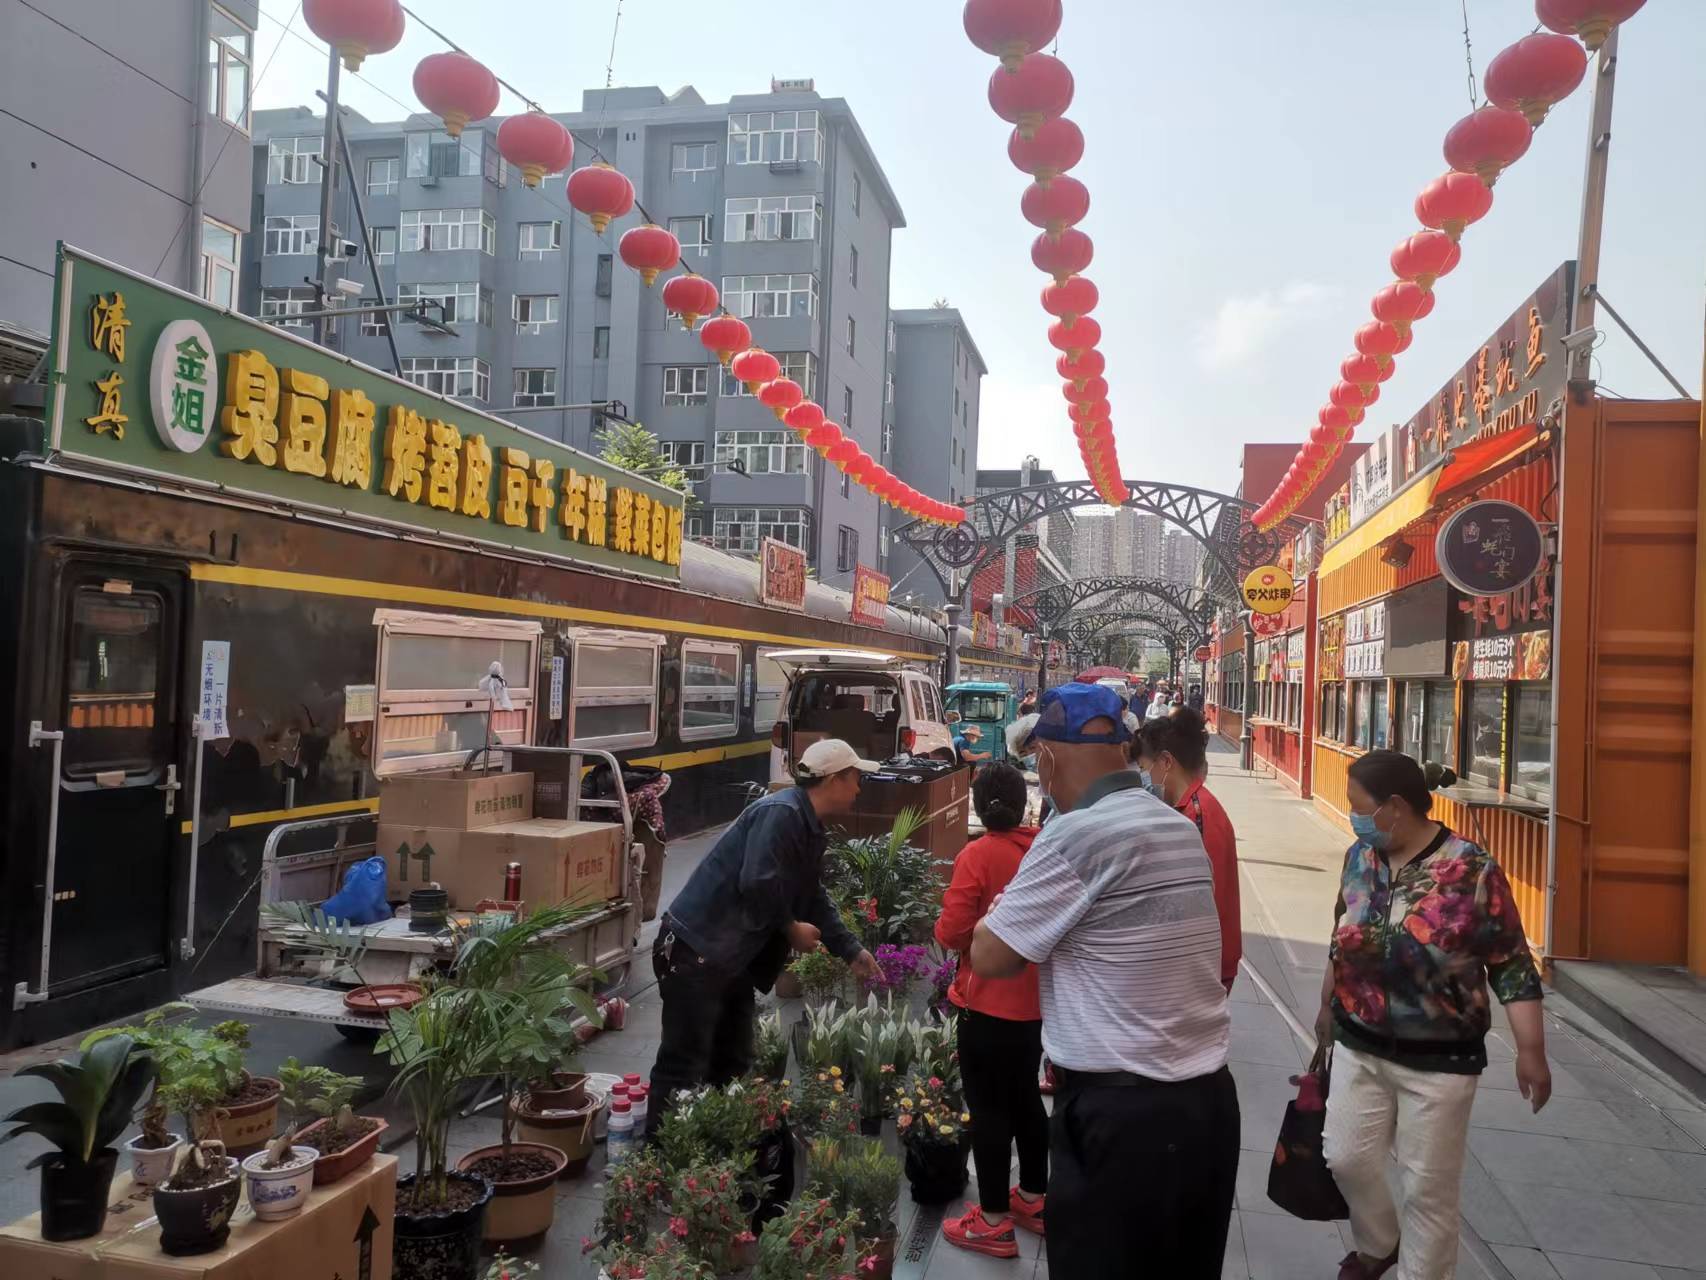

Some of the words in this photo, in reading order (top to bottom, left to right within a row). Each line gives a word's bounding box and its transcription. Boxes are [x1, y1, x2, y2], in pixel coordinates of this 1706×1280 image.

[82, 291, 132, 441] 清真
[170, 334, 210, 436] 金姐
[220, 349, 376, 491] 臭豆腐
[203, 663, 214, 721] 无烟环境
[213, 682, 224, 735] 一片清新
